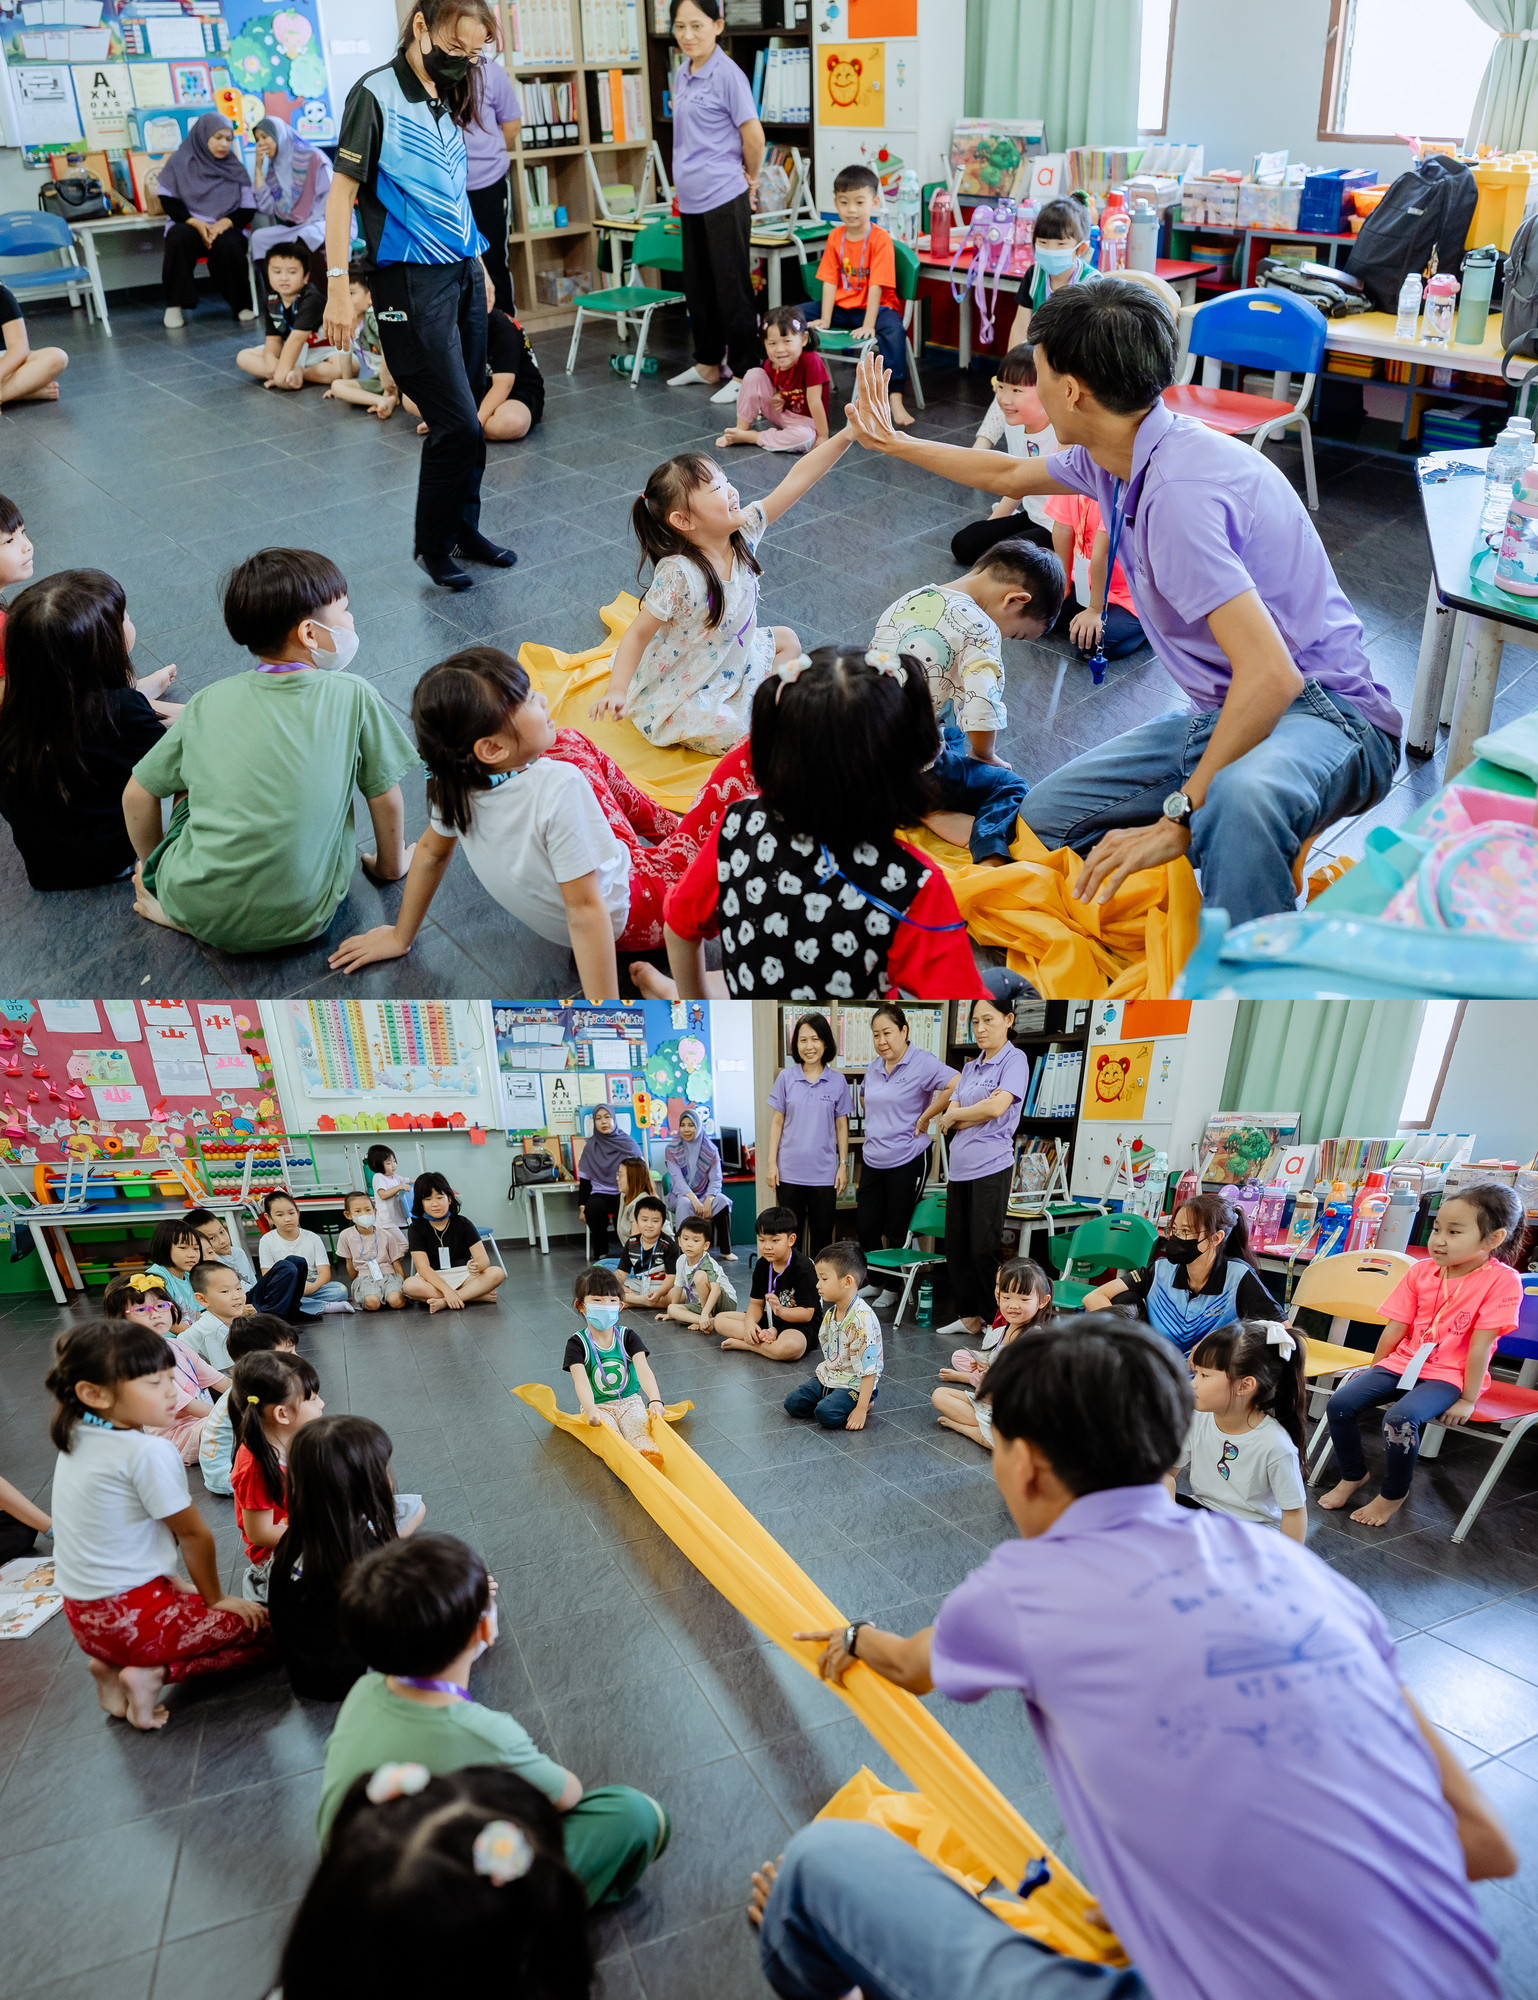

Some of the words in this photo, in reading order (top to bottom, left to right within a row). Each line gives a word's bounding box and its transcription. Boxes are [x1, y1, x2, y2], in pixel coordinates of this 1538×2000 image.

[94, 72, 109, 88] A
[91, 91, 99, 99] X
[106, 90, 116, 98] N
[1037, 168, 1054, 186] a
[592, 1014, 616, 1024] Jadual
[619, 1014, 644, 1025] Waktu
[554, 1078, 566, 1091] A
[1285, 1156, 1305, 1175] a
